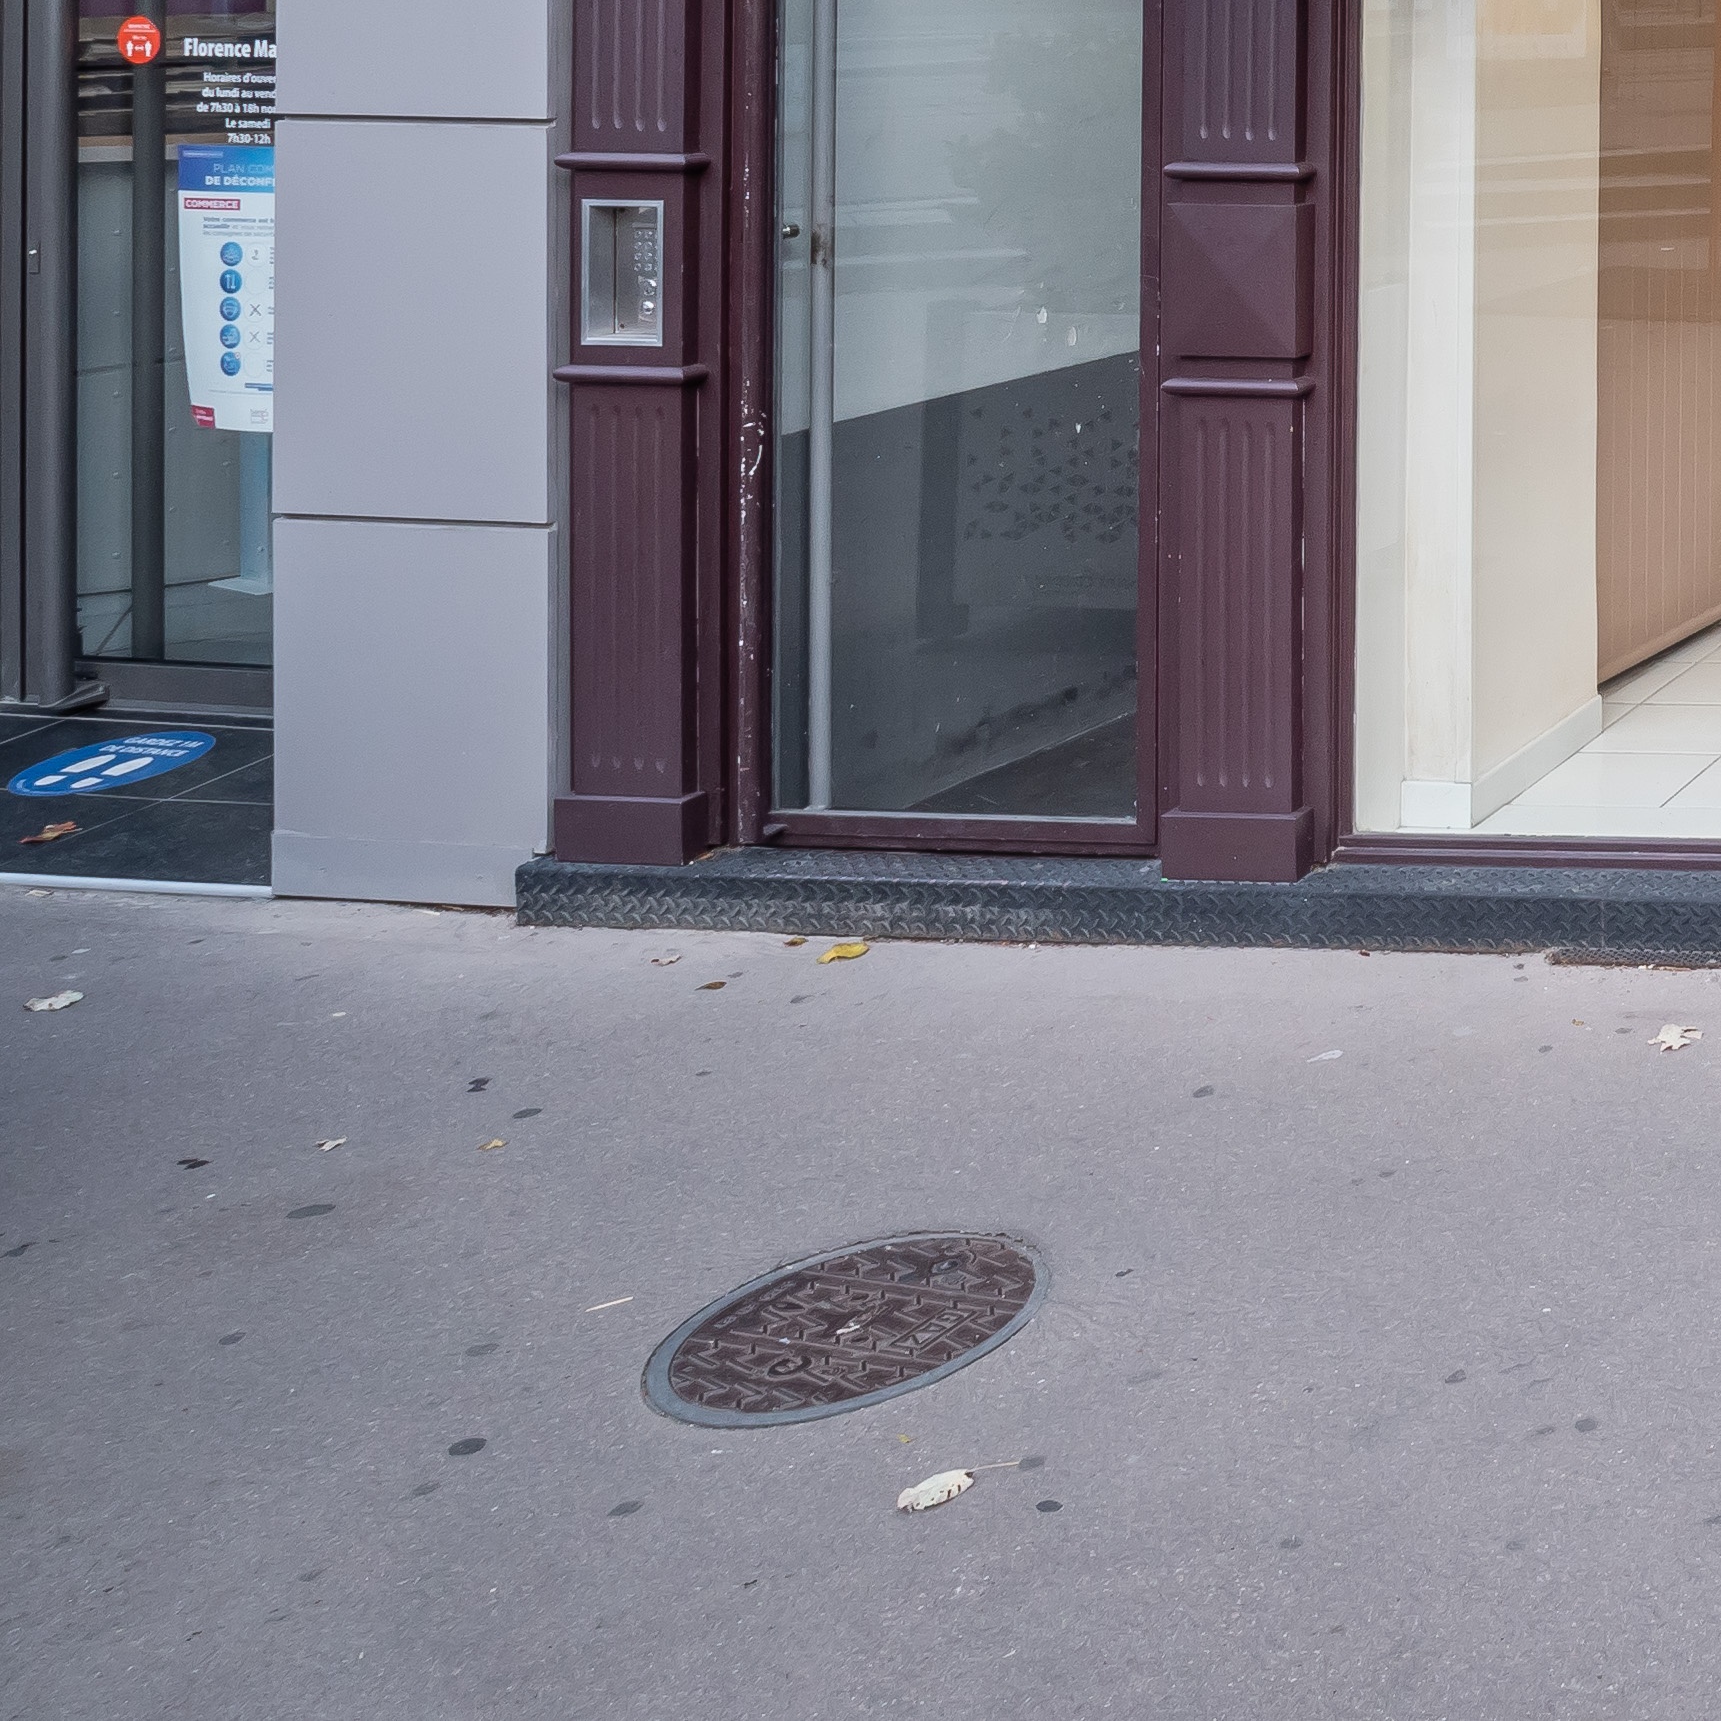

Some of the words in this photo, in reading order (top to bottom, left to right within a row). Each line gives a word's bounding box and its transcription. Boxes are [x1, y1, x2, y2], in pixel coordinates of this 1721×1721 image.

[183, 37, 251, 59] Florence
[203, 71, 242, 83] Horaires
[201, 87, 215, 98] du
[215, 87, 240, 98] lundi
[196, 102, 209, 113] de
[210, 102, 233, 113] 7h30
[225, 117, 237, 128] Le
[238, 118, 271, 128] samedi
[205, 175, 221, 186] DE
[185, 199, 239, 209] COMMERCE
